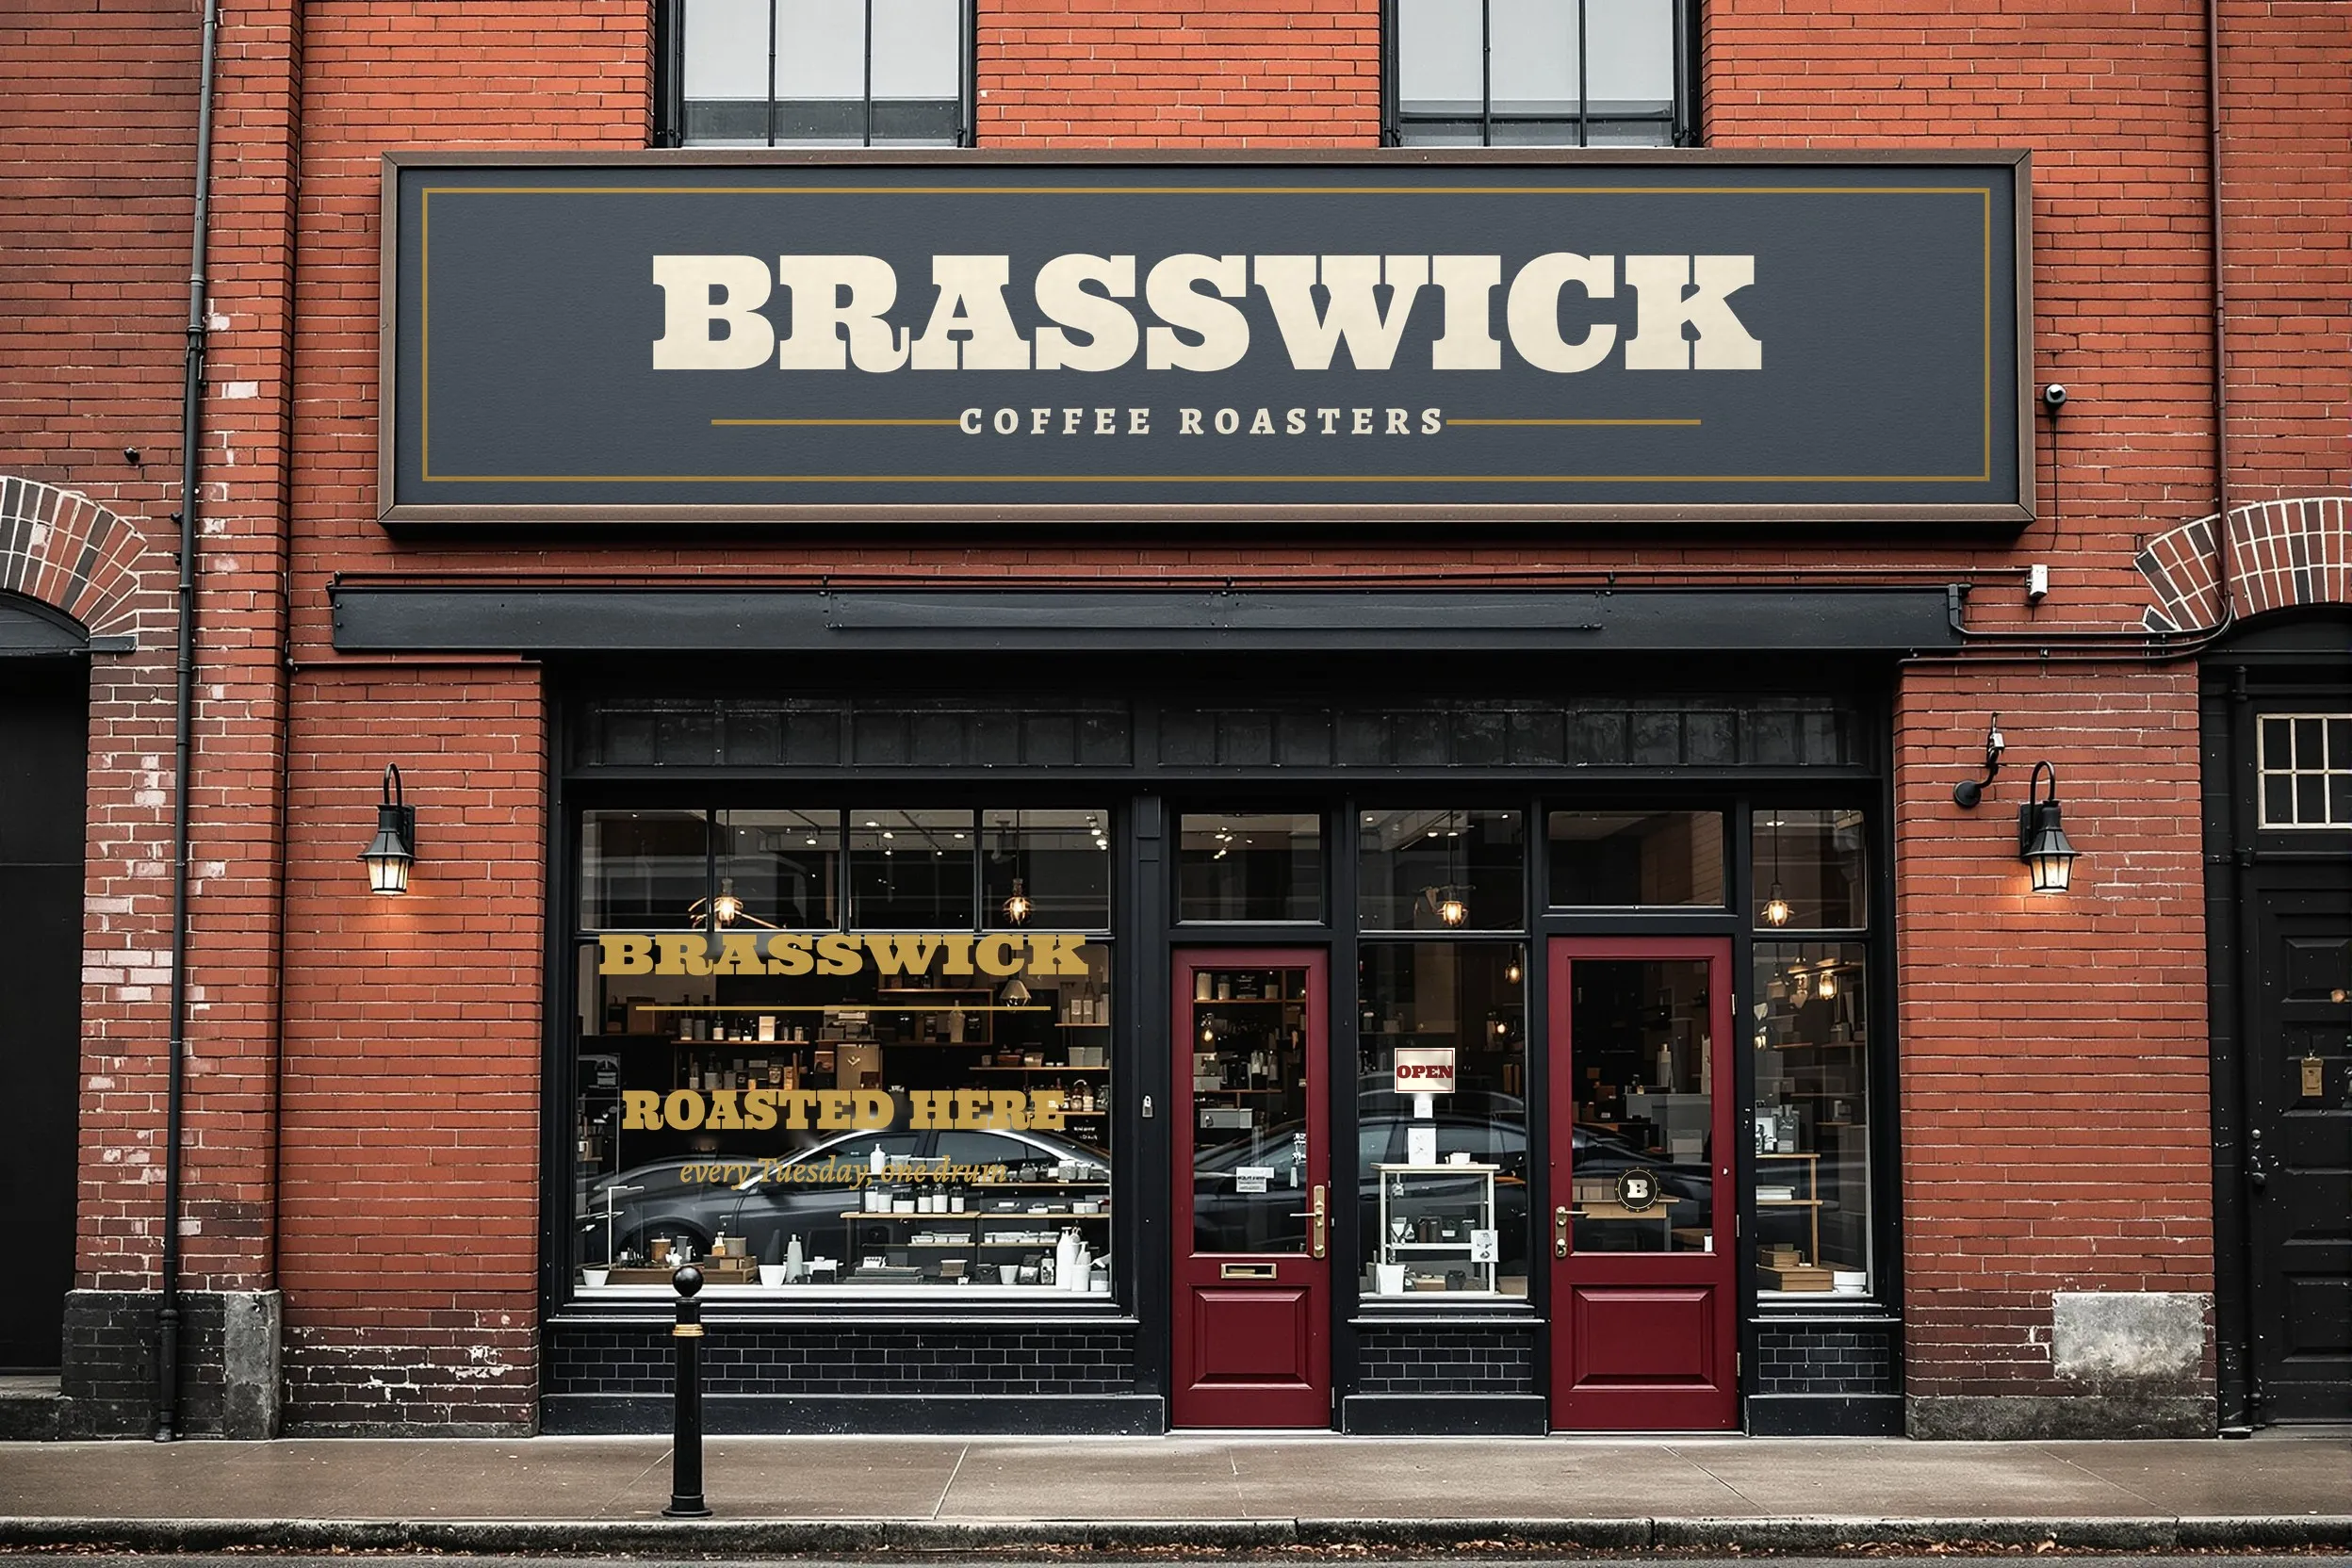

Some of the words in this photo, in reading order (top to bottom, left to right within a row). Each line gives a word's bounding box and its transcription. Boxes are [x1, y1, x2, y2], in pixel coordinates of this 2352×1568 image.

[652, 253, 1762, 373] BRASSWICK
[959, 407, 1151, 435] COFFEE
[1179, 407, 1443, 435] ROASTERS
[598, 934, 1089, 976] BRASSWICK
[1396, 1065, 1454, 1079] OPEN
[622, 1089, 895, 1131] ROASTED
[909, 1089, 1066, 1131] HERE
[679, 1164, 751, 1191] every
[758, 1154, 874, 1191] Tuesday,
[880, 1164, 927, 1184] one
[932, 1154, 1008, 1184] drum
[1627, 1179, 1648, 1199] B
